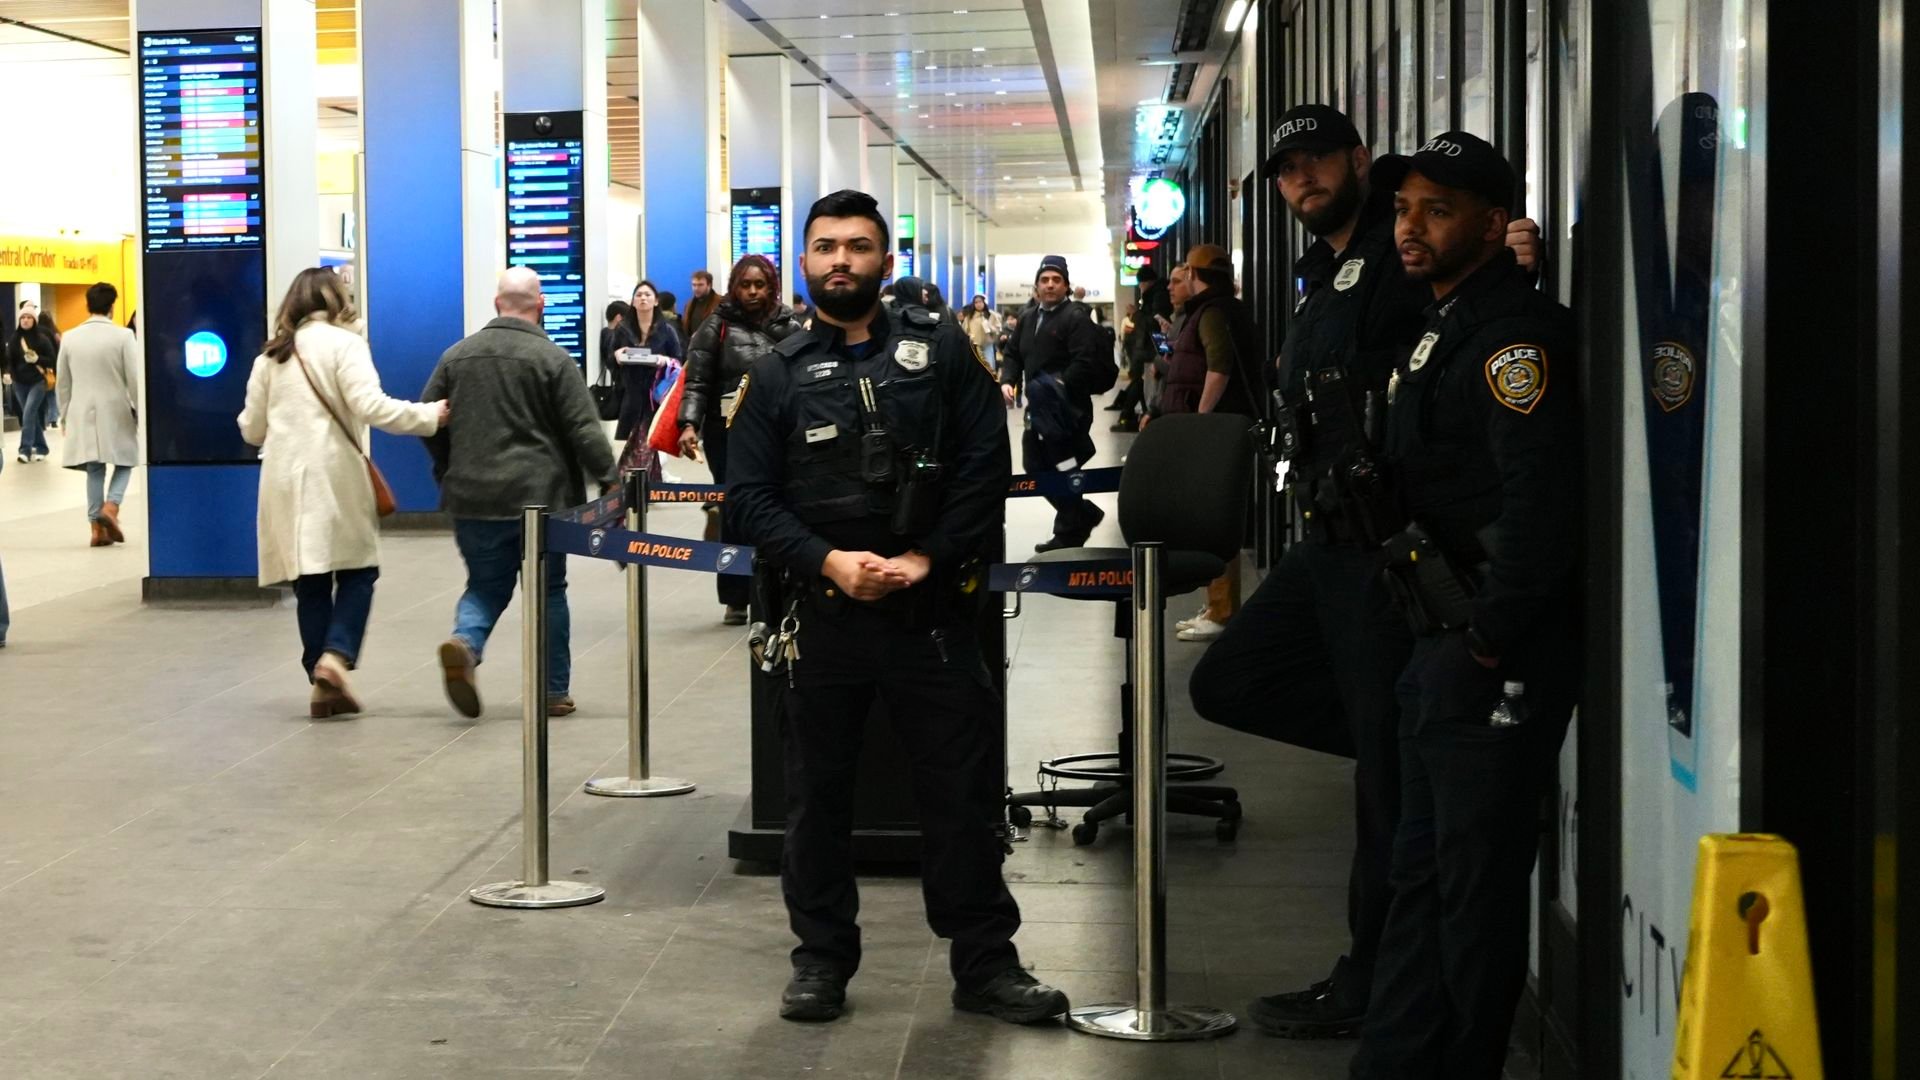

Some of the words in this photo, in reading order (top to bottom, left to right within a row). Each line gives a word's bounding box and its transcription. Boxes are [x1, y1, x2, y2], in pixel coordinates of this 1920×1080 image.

[1272, 117, 1318, 148] MTAPD
[570, 156, 580, 165] 17
[22, 245, 56, 268] Corridor
[1491, 348, 1540, 376] POLICE
[650, 490, 676, 501] MTA
[679, 491, 725, 502] POLICE
[627, 541, 650, 556] MTA
[650, 545, 693, 561] POLICE
[1068, 571, 1095, 586] MTA
